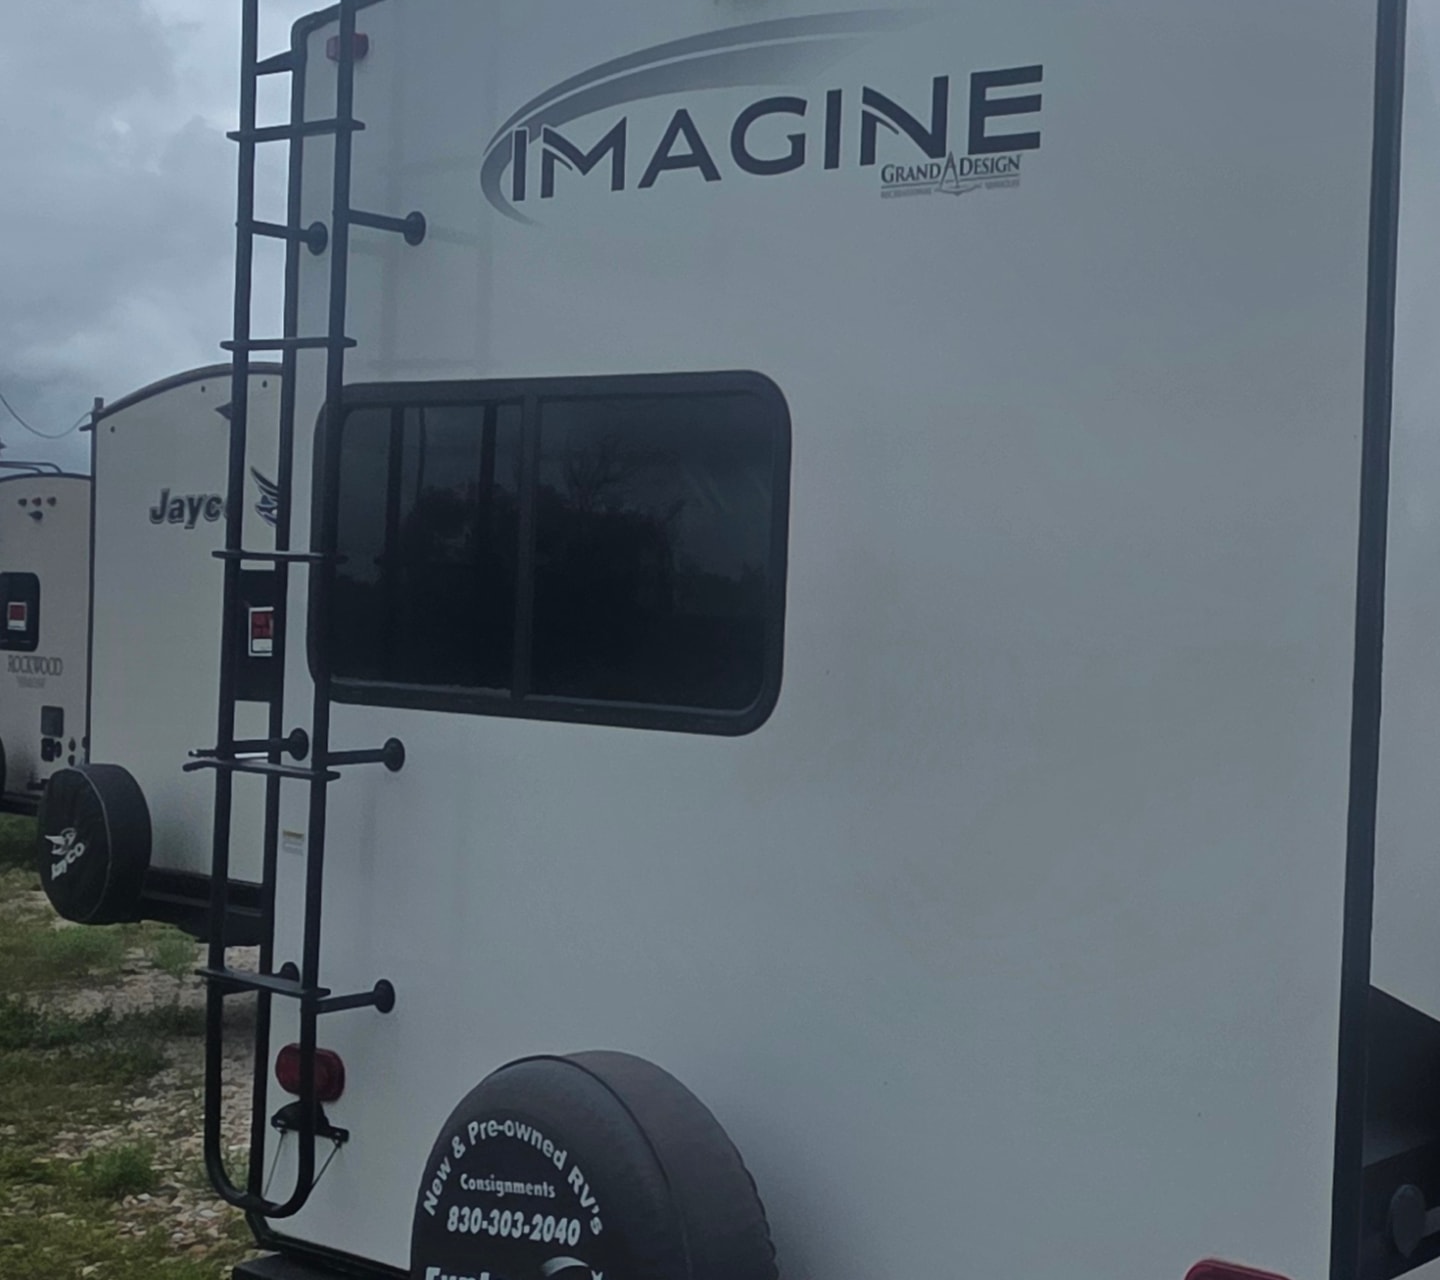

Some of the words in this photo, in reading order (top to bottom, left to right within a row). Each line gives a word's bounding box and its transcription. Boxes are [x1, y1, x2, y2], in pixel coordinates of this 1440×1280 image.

[511, 65, 1044, 201] IMAGINE
[880, 162, 941, 184] GRAND
[959, 154, 1021, 177] DESIGN
[149, 488, 229, 529] Jayc
[423, 1156, 452, 1216] New
[452, 1136, 466, 1159] &
[468, 1120, 567, 1170] Pre-owned
[568, 1165, 602, 1235] RV's
[460, 1173, 556, 1199] Consignments
[447, 1205, 581, 1246] 830-303-2040
